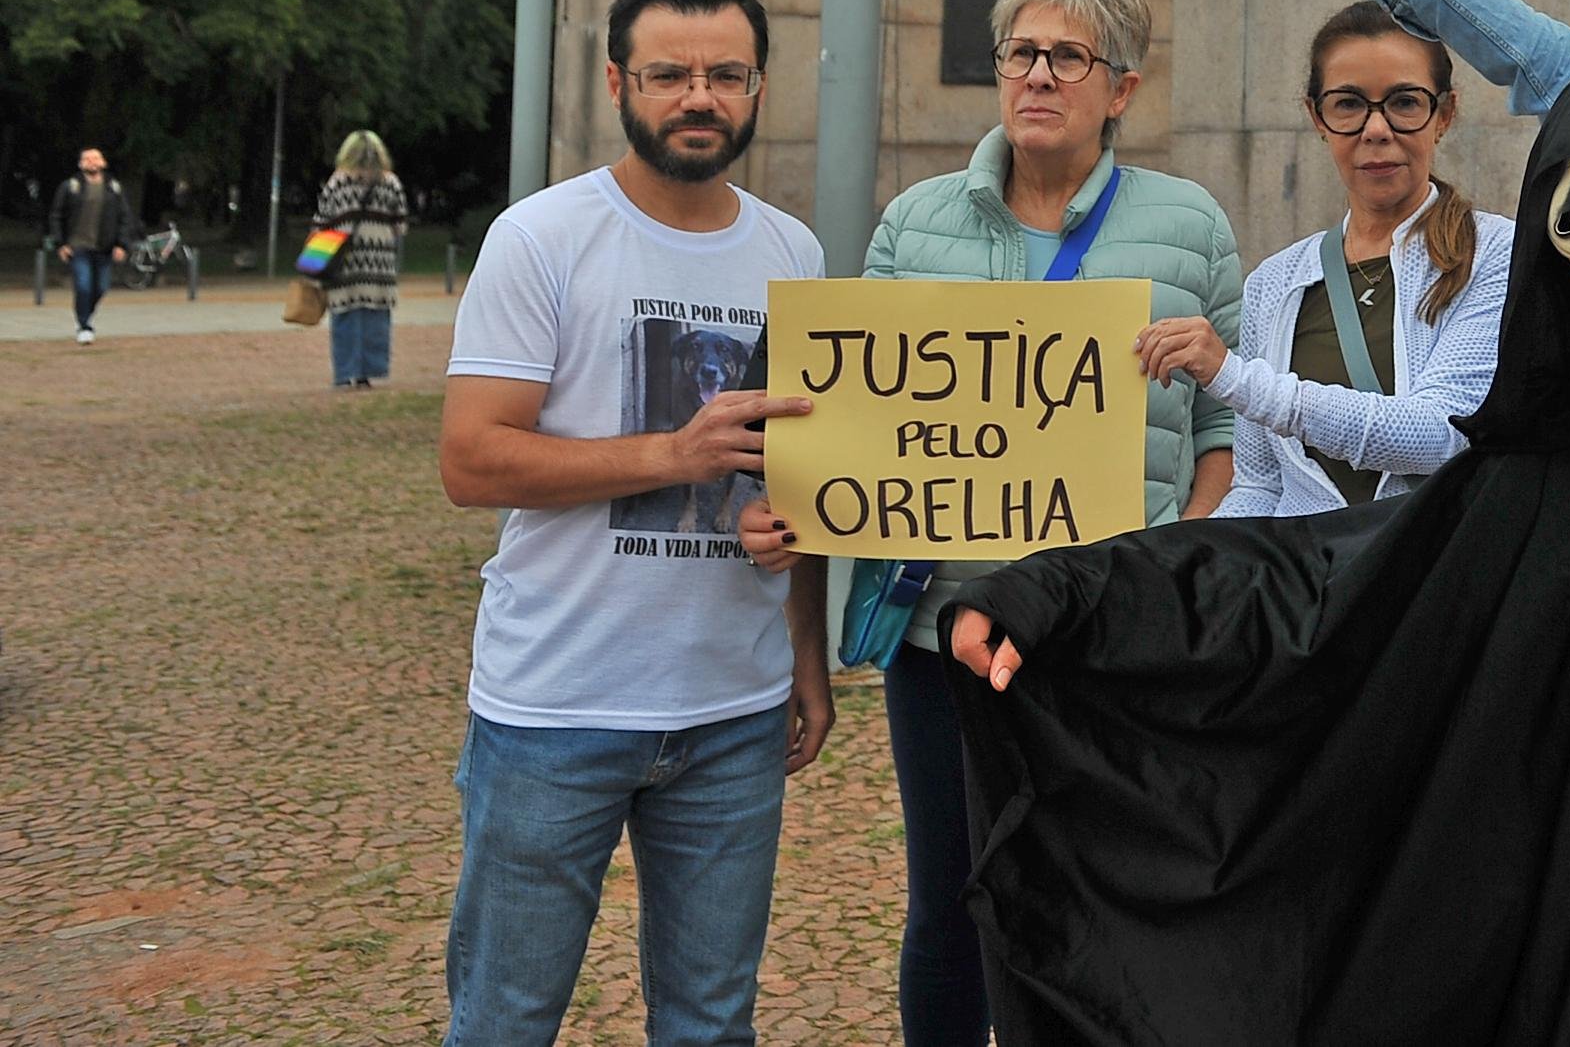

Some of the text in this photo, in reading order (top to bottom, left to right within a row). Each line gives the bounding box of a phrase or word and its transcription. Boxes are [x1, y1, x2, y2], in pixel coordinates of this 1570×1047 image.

[632, 298, 687, 320] JUSTIÇA
[690, 304, 724, 323] POR
[896, 420, 1008, 459] PELO
[815, 476, 1080, 543] ORELHA
[613, 535, 658, 557] TODA
[664, 538, 701, 558] VIDA
